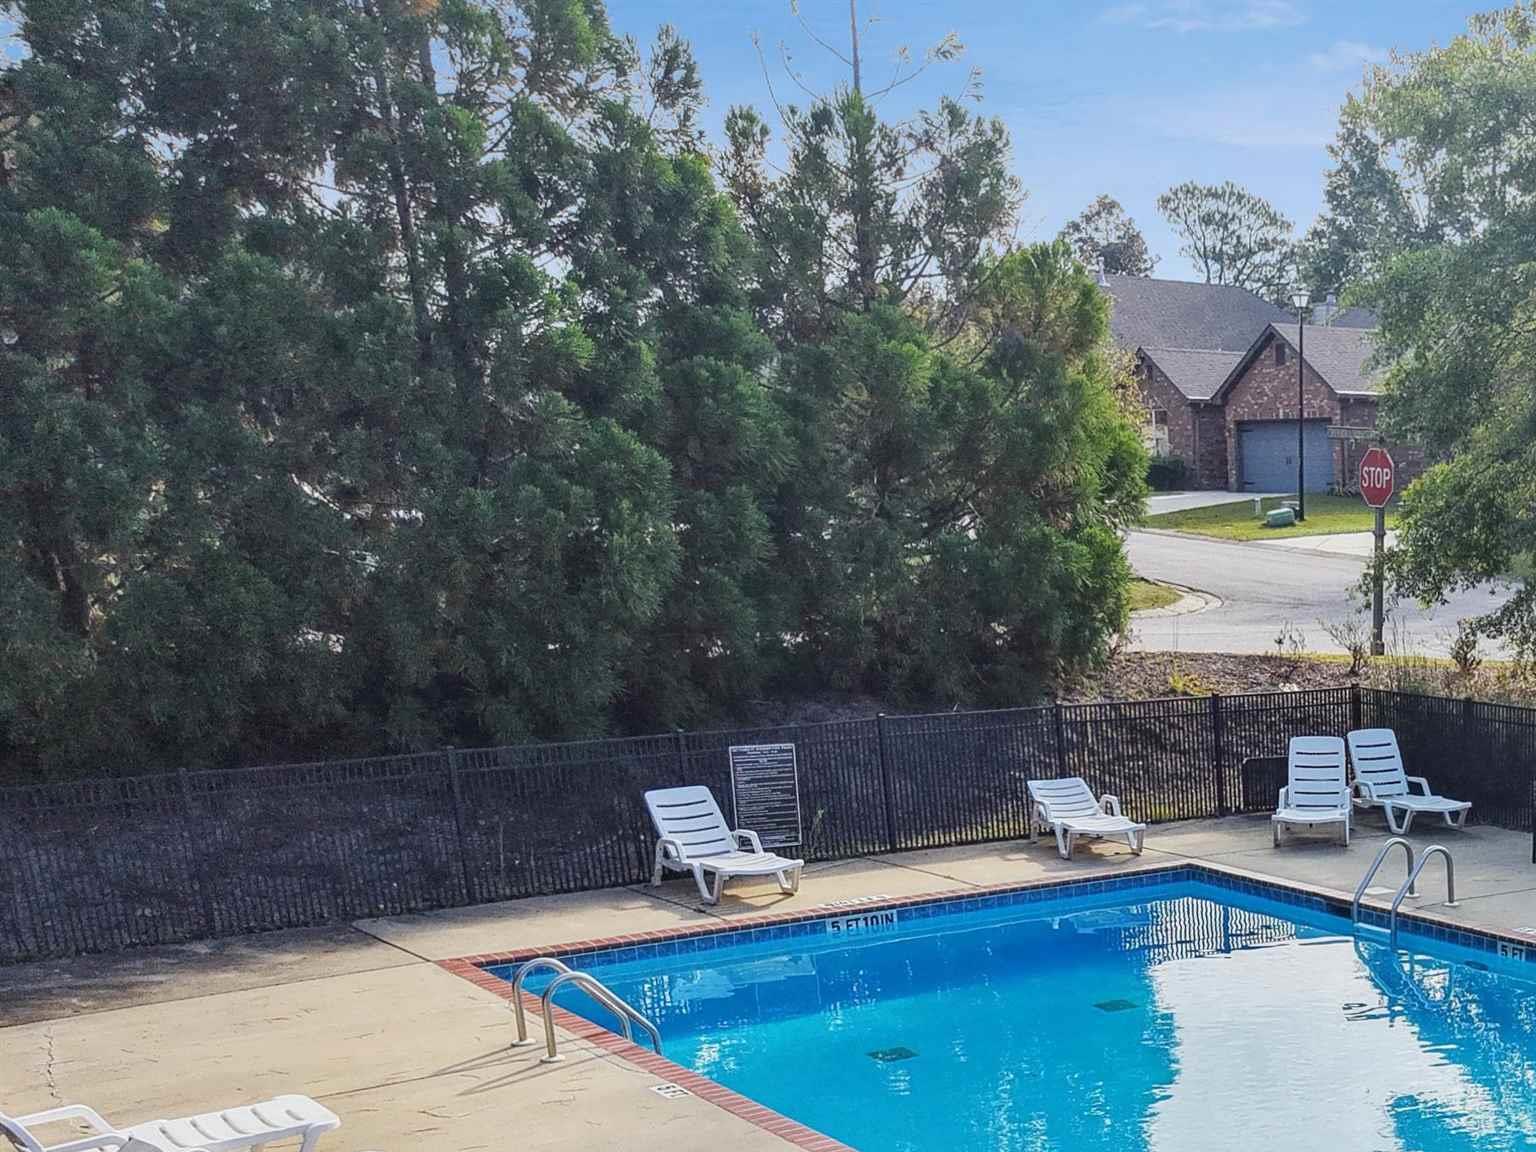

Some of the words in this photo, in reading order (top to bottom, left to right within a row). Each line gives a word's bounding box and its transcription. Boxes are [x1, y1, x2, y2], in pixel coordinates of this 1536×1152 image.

[1361, 466, 1391, 489] STOP
[831, 921, 841, 933] 5
[881, 912, 895, 926] IN
[1501, 944, 1508, 957] 5
